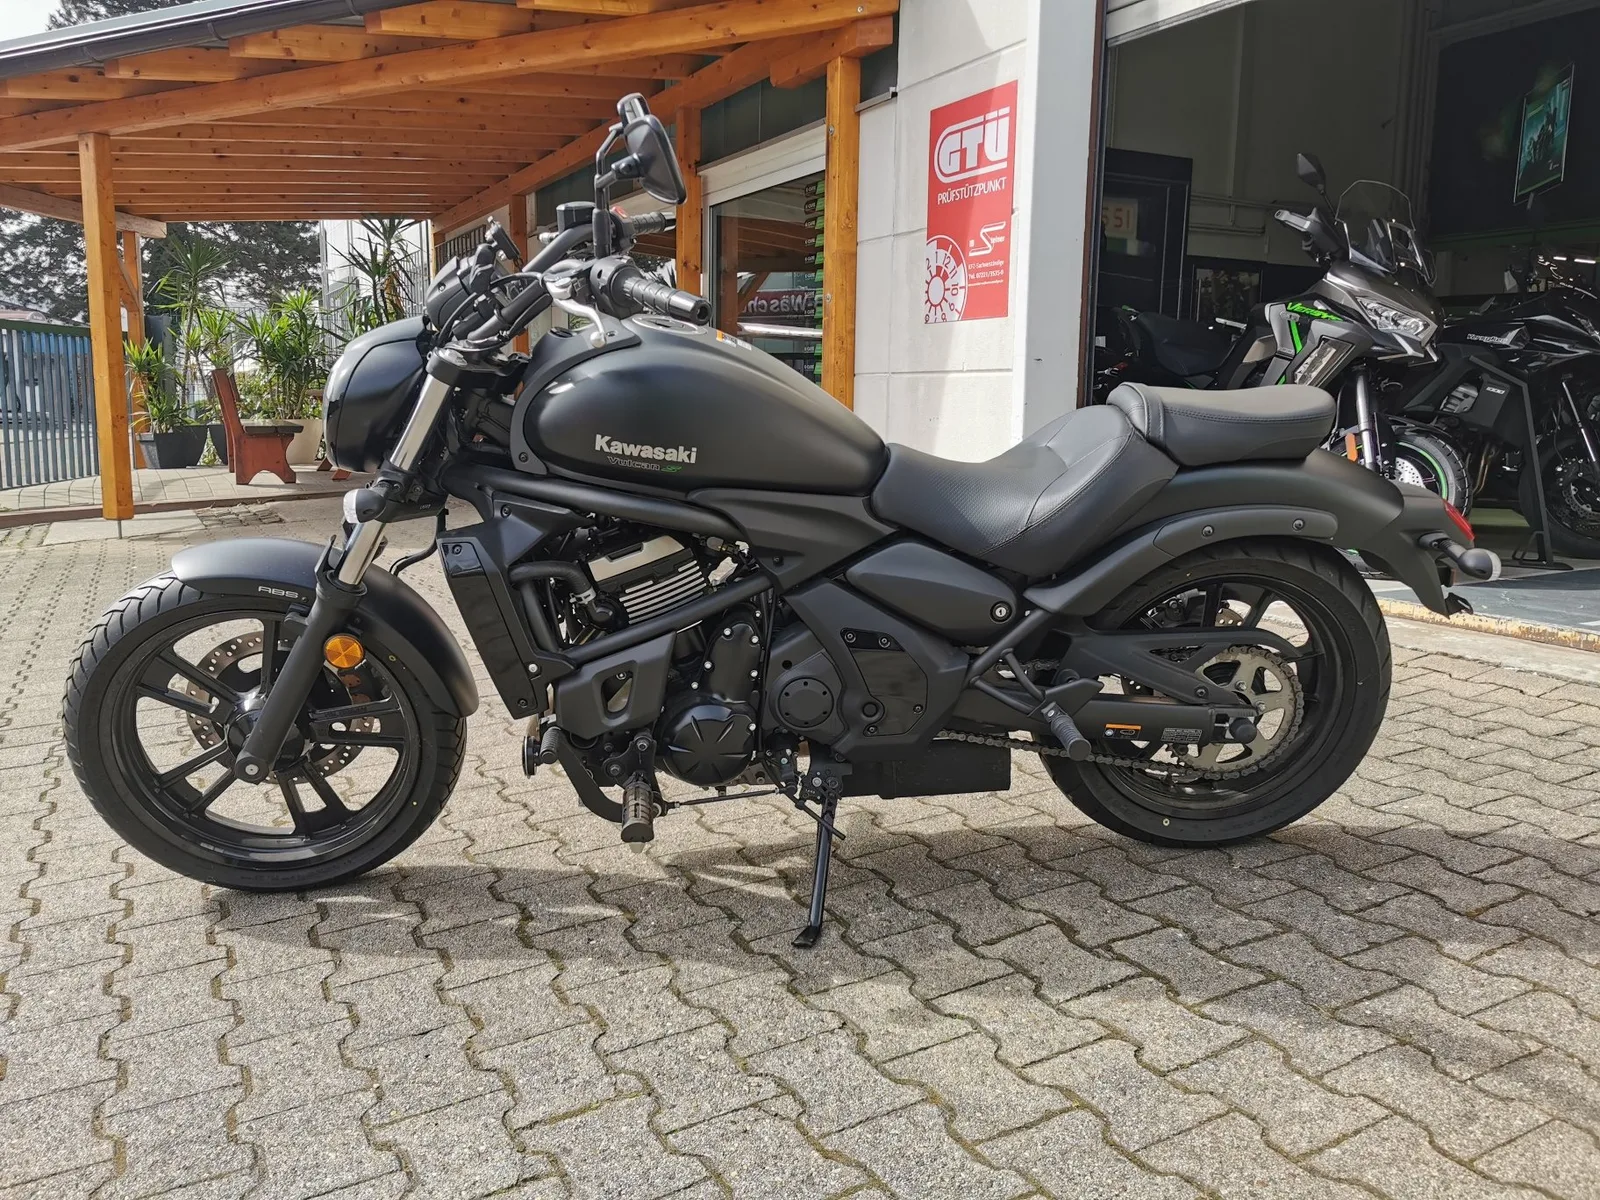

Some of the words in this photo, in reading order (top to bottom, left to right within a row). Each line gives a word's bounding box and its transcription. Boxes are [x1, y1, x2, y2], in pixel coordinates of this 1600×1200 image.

[937, 106, 1010, 175] GTÜ
[937, 176, 1007, 205] PRÜFSTÜTZPUNKT
[942, 253, 952, 268] 12
[950, 283, 959, 297] 10
[595, 434, 697, 464] Kawasaki
[258, 586, 298, 598] ABS
